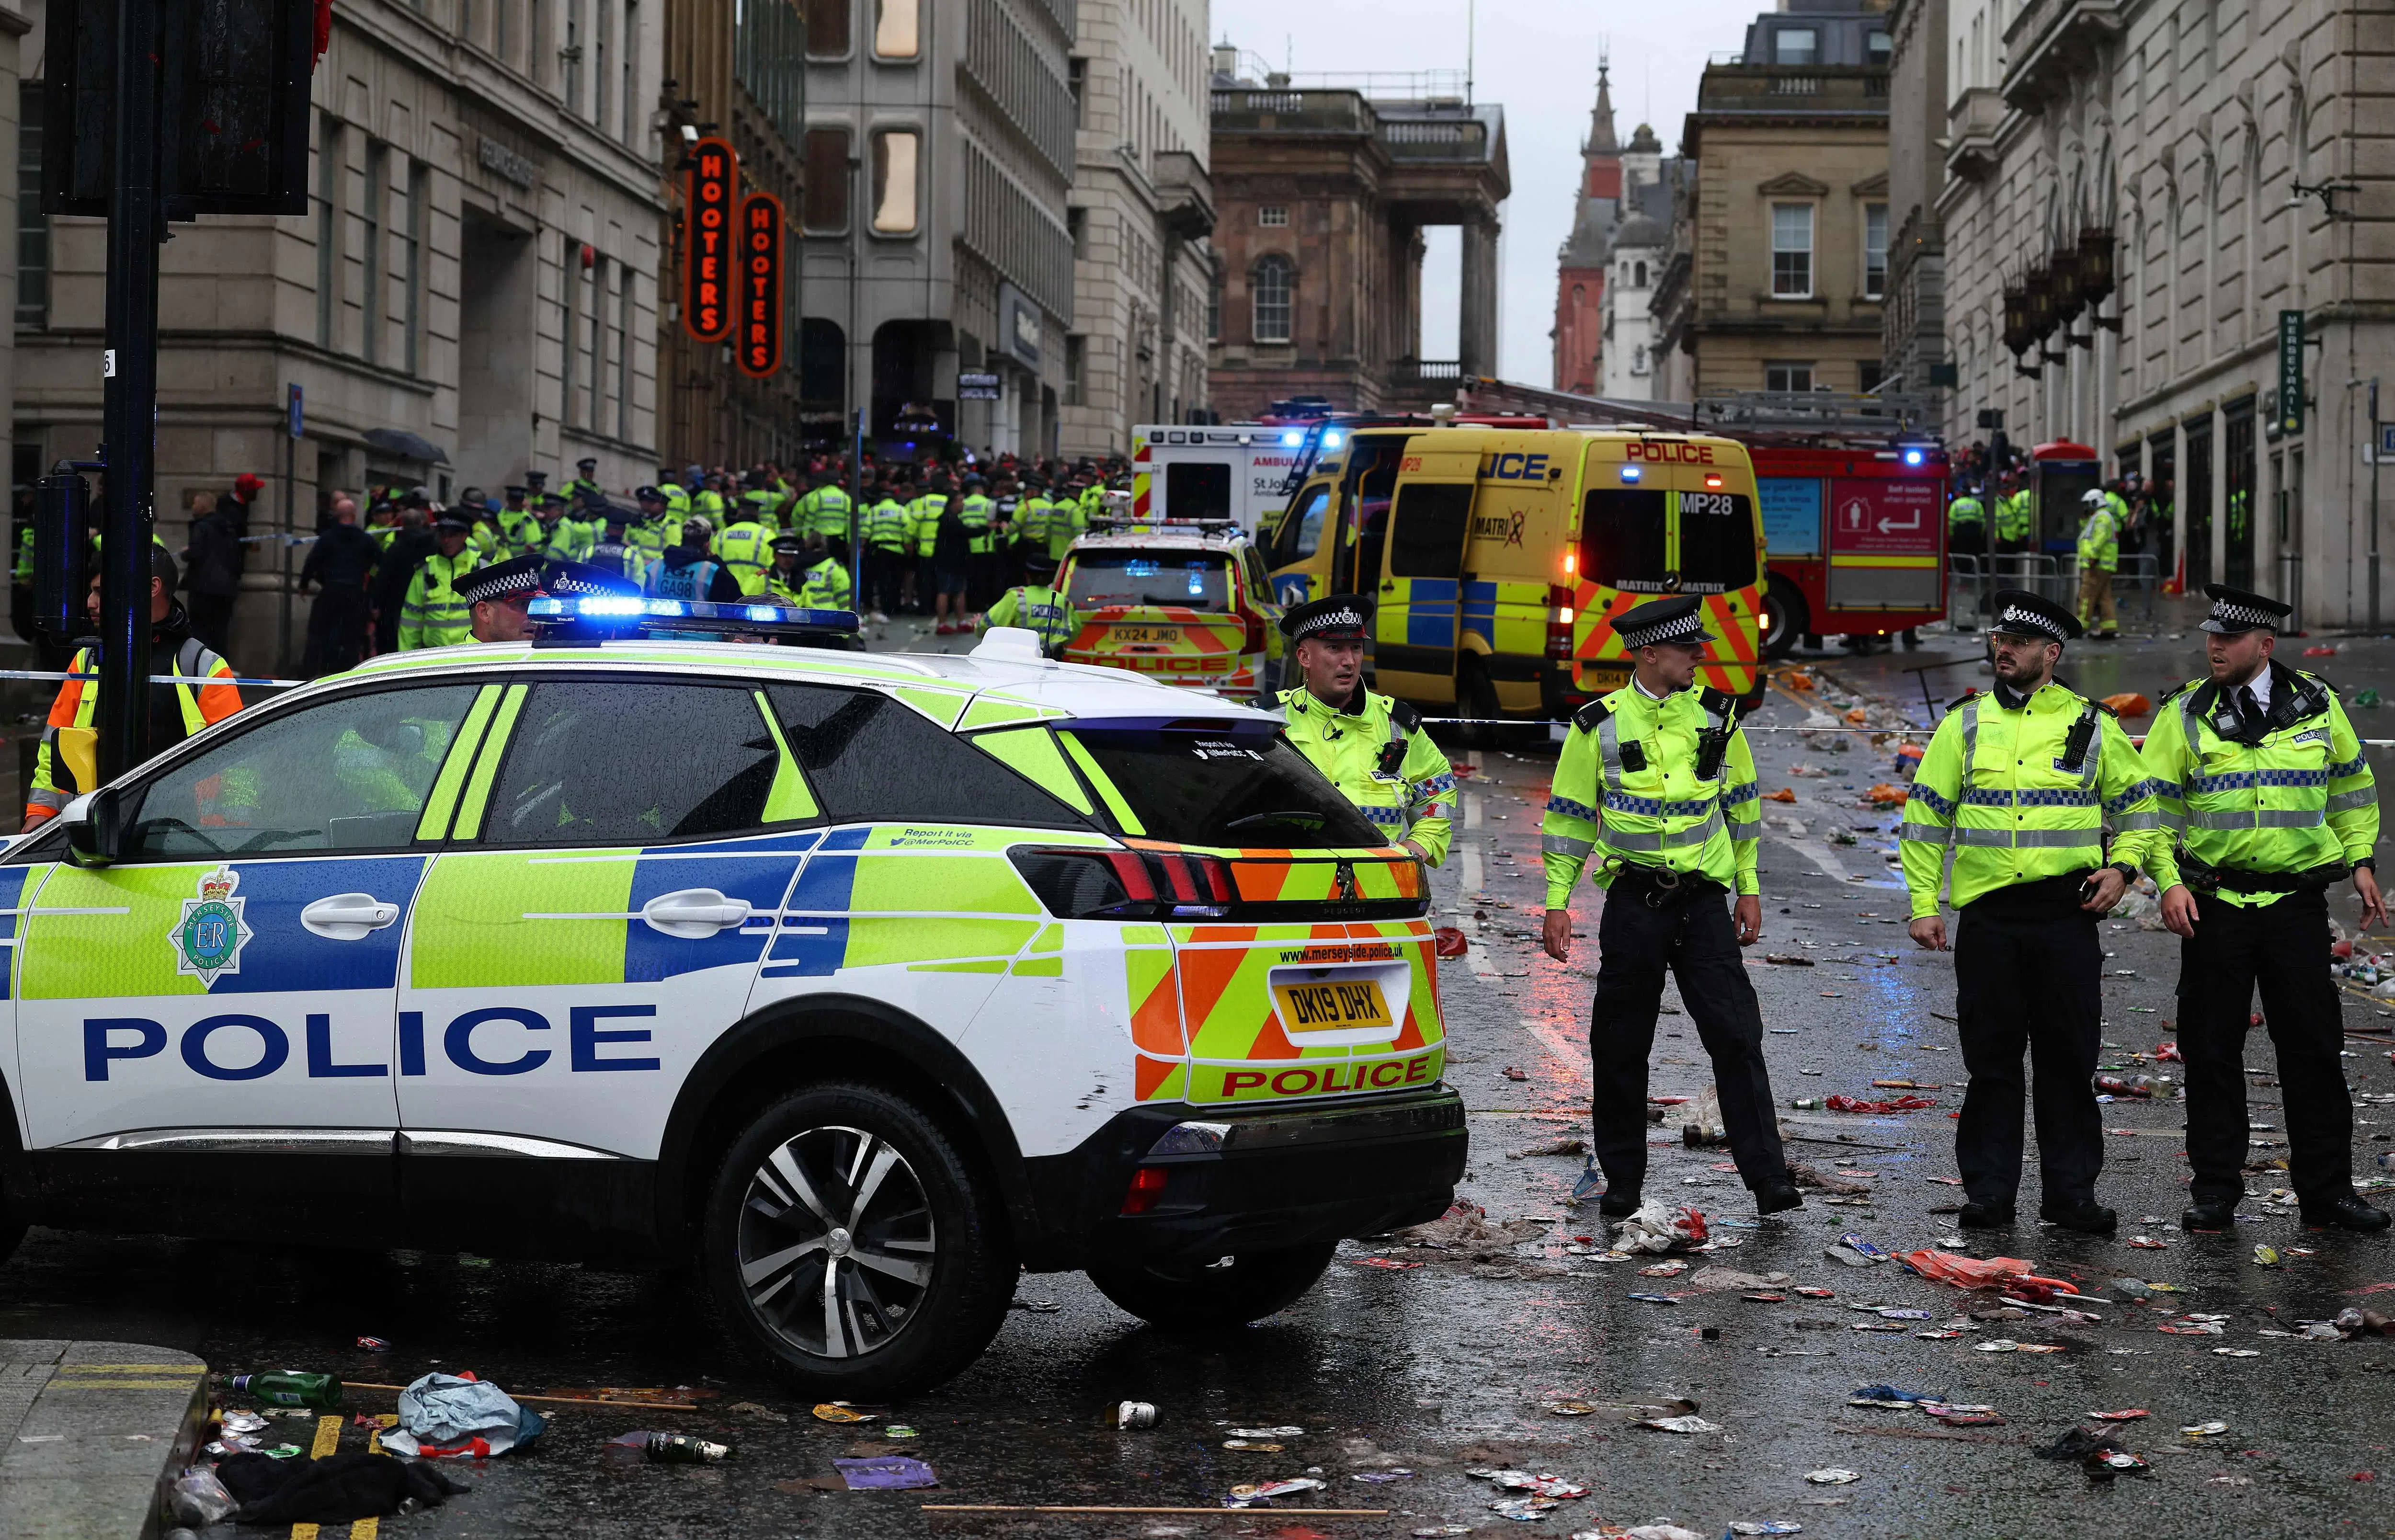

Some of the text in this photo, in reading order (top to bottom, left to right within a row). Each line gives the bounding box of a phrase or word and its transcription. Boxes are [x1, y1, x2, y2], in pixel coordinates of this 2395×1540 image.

[701, 155, 721, 331] HOOTERS
[751, 208, 770, 368] HOOTERS
[104, 354, 110, 373] 6
[2286, 315, 2298, 415] MERSEYRAIL
[1626, 443, 1714, 464] POLICE
[1478, 453, 1549, 480] ICE
[1254, 478, 1266, 489] St
[1679, 493, 1733, 515] MP28
[727, 531, 751, 539] POLICE
[594, 544, 623, 557] POLICE
[660, 579, 692, 598] GA98
[1616, 579, 1725, 593] MATRIX MATRIX
[1114, 626, 1178, 641] KX24 JMO
[1063, 654, 1228, 671] POLICE
[1596, 672, 1620, 684] DK14
[1720, 698, 1729, 710] 1043
[1578, 714, 1588, 727] 1043
[2295, 731, 2322, 741] POLICE
[904, 829, 943, 838] Report
[187, 904, 235, 930] MERSEYSIDE
[1323, 907, 1367, 915] PEUGEOT
[193, 954, 225, 967] POLICE
[1279, 943, 1403, 963] www.merseyside.police.uk
[1288, 985, 1381, 1024] DK19 DHX
[83, 1004, 661, 1082] POLICE
[1221, 1055, 1429, 1097] POLICE
